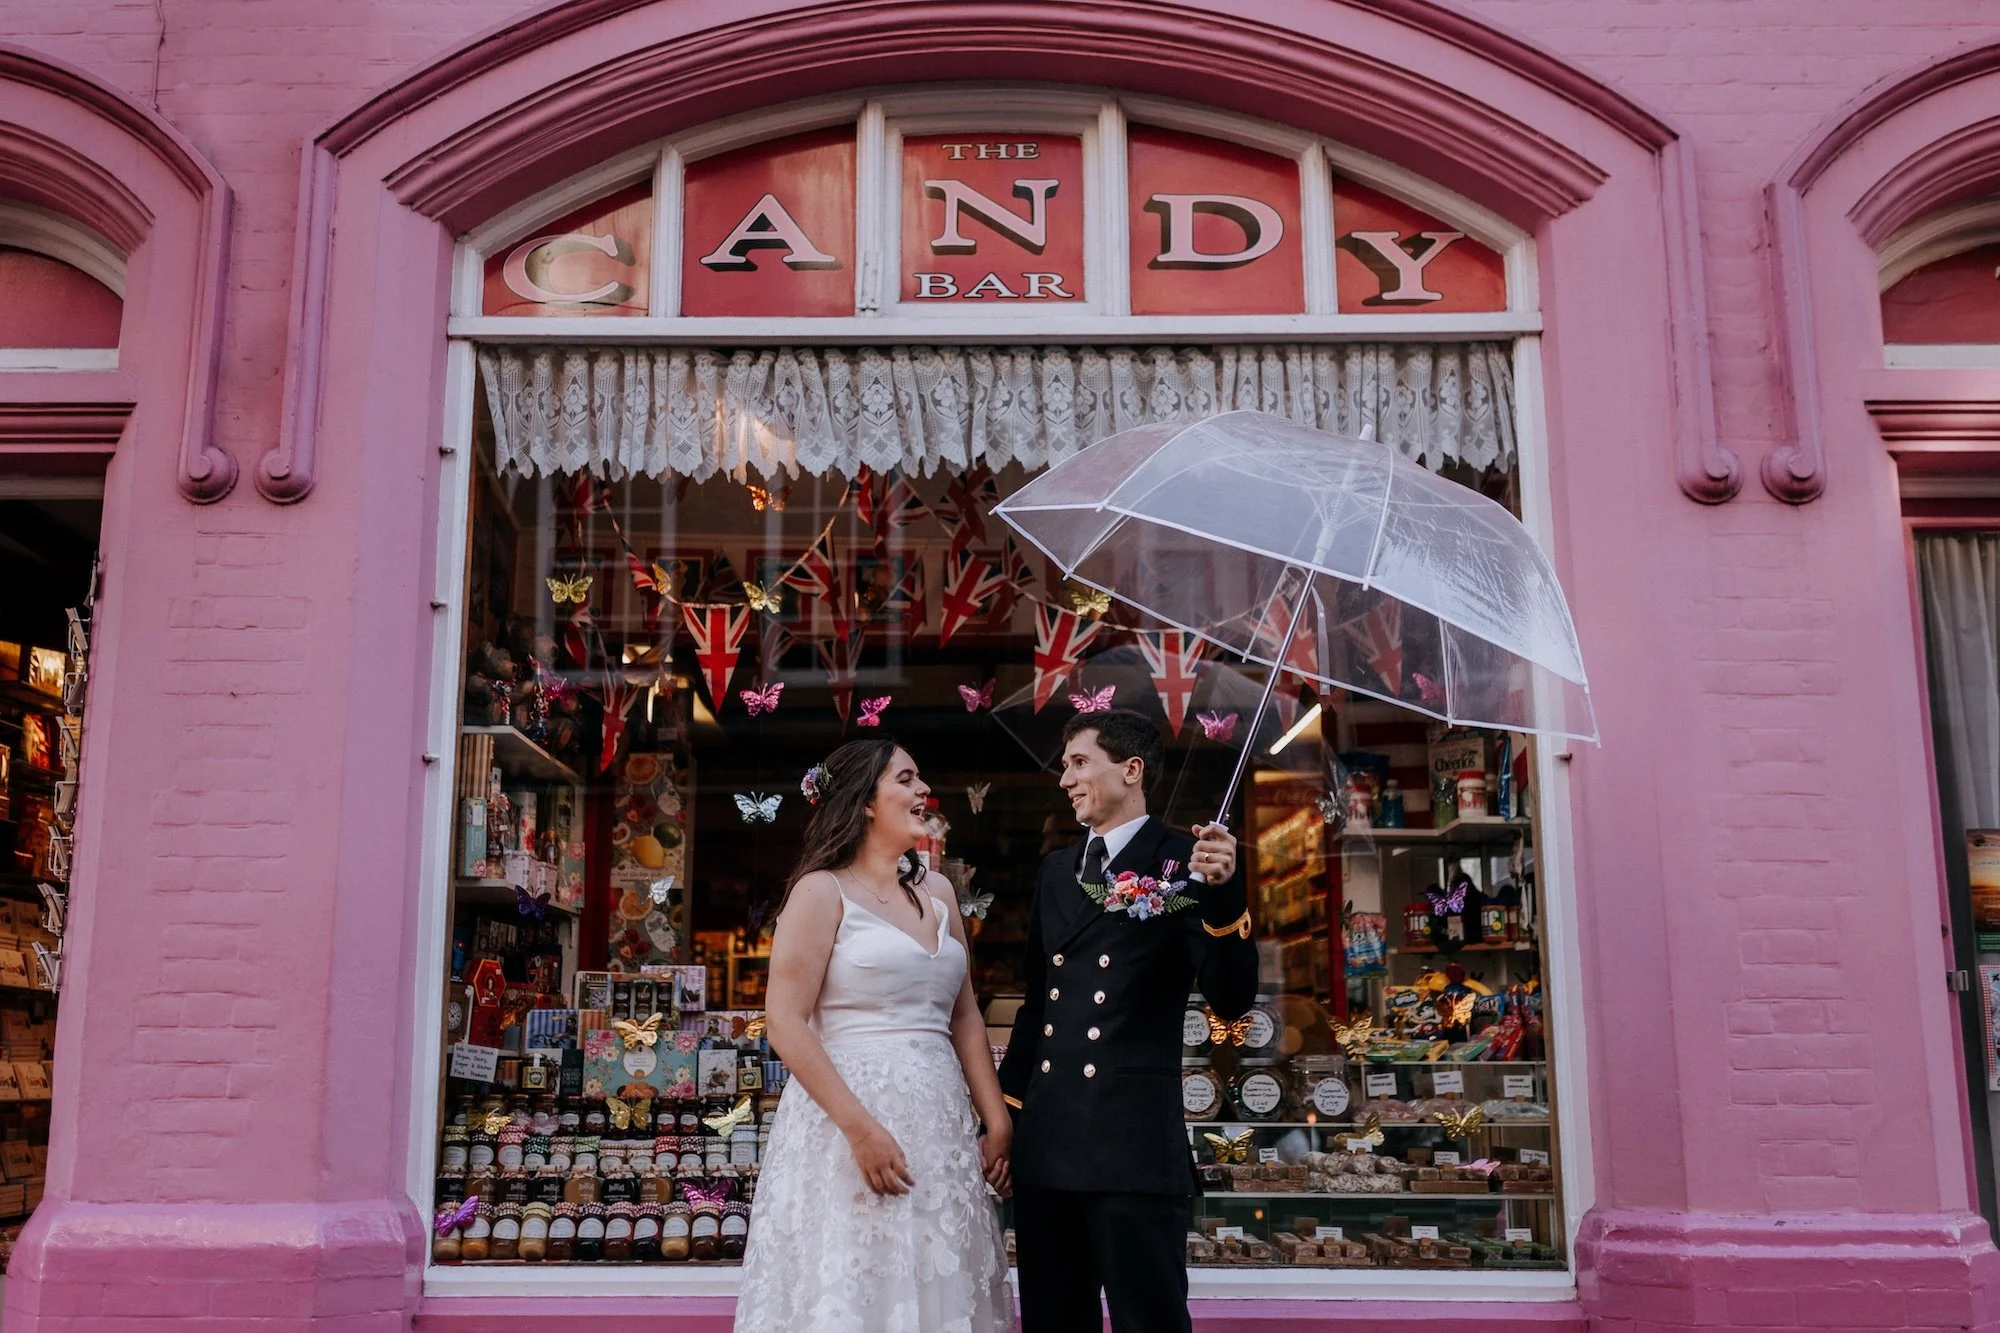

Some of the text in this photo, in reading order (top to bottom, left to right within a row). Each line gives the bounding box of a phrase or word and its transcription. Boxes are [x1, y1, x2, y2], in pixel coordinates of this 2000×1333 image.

[941, 142, 1041, 160] THE
[502, 178, 1466, 306] CANDY
[914, 272, 1075, 300] BAR
